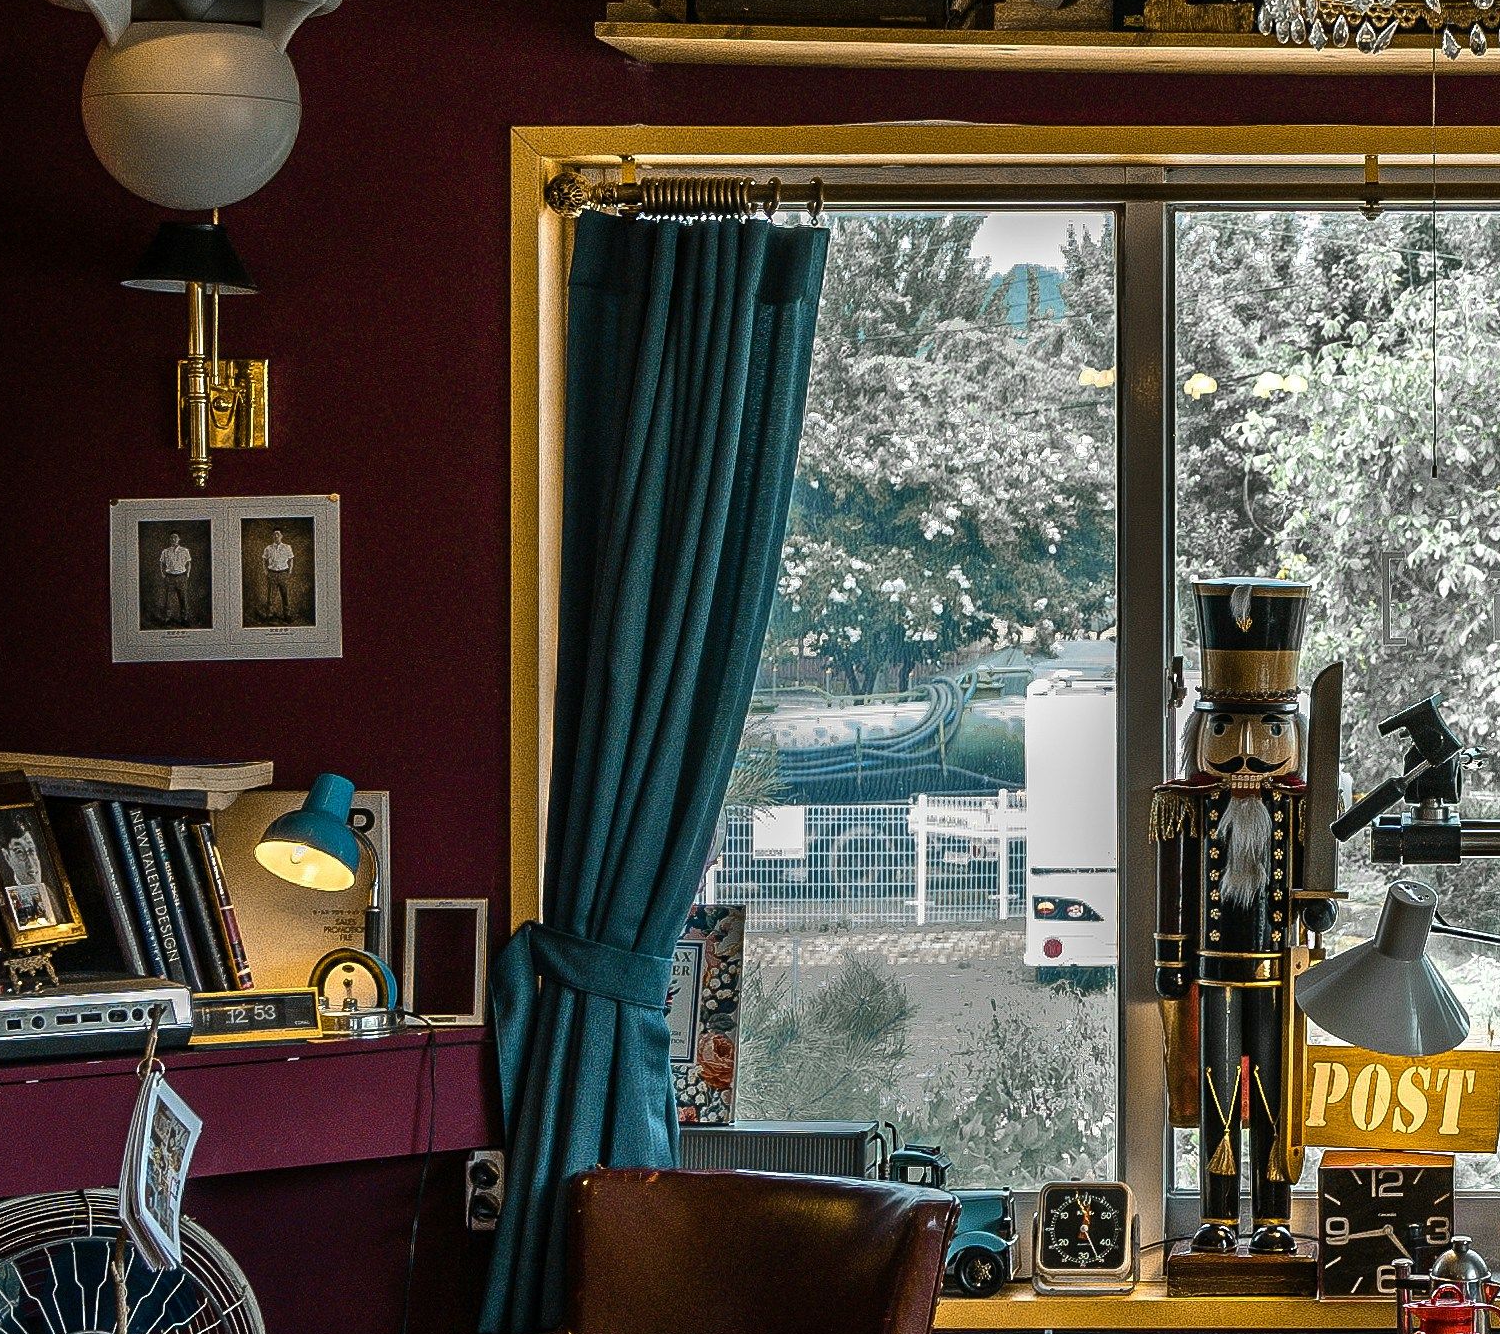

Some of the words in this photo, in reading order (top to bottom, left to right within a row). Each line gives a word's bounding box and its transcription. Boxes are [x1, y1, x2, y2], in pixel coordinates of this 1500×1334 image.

[129, 809, 151, 848] NEW
[141, 850, 165, 903] TALENT
[154, 906, 181, 962] DESIGN
[323, 925, 365, 934] PROMOTIO
[672, 952, 692, 962] AX
[672, 966, 690, 976] ER
[227, 1008, 249, 1024] 12
[254, 1005, 276, 1020] 53
[1305, 1062, 1475, 1136] POST
[1371, 1170, 1404, 1197] 12
[1060, 1211, 1069, 1219] 10
[1325, 1218, 1349, 1245] 9
[1425, 1218, 1451, 1245] 3
[1058, 1238, 1069, 1246] 20
[1100, 1238, 1111, 1246] 40
[1078, 1252, 1090, 1260] 30
[1375, 1265, 1399, 1293] 6
